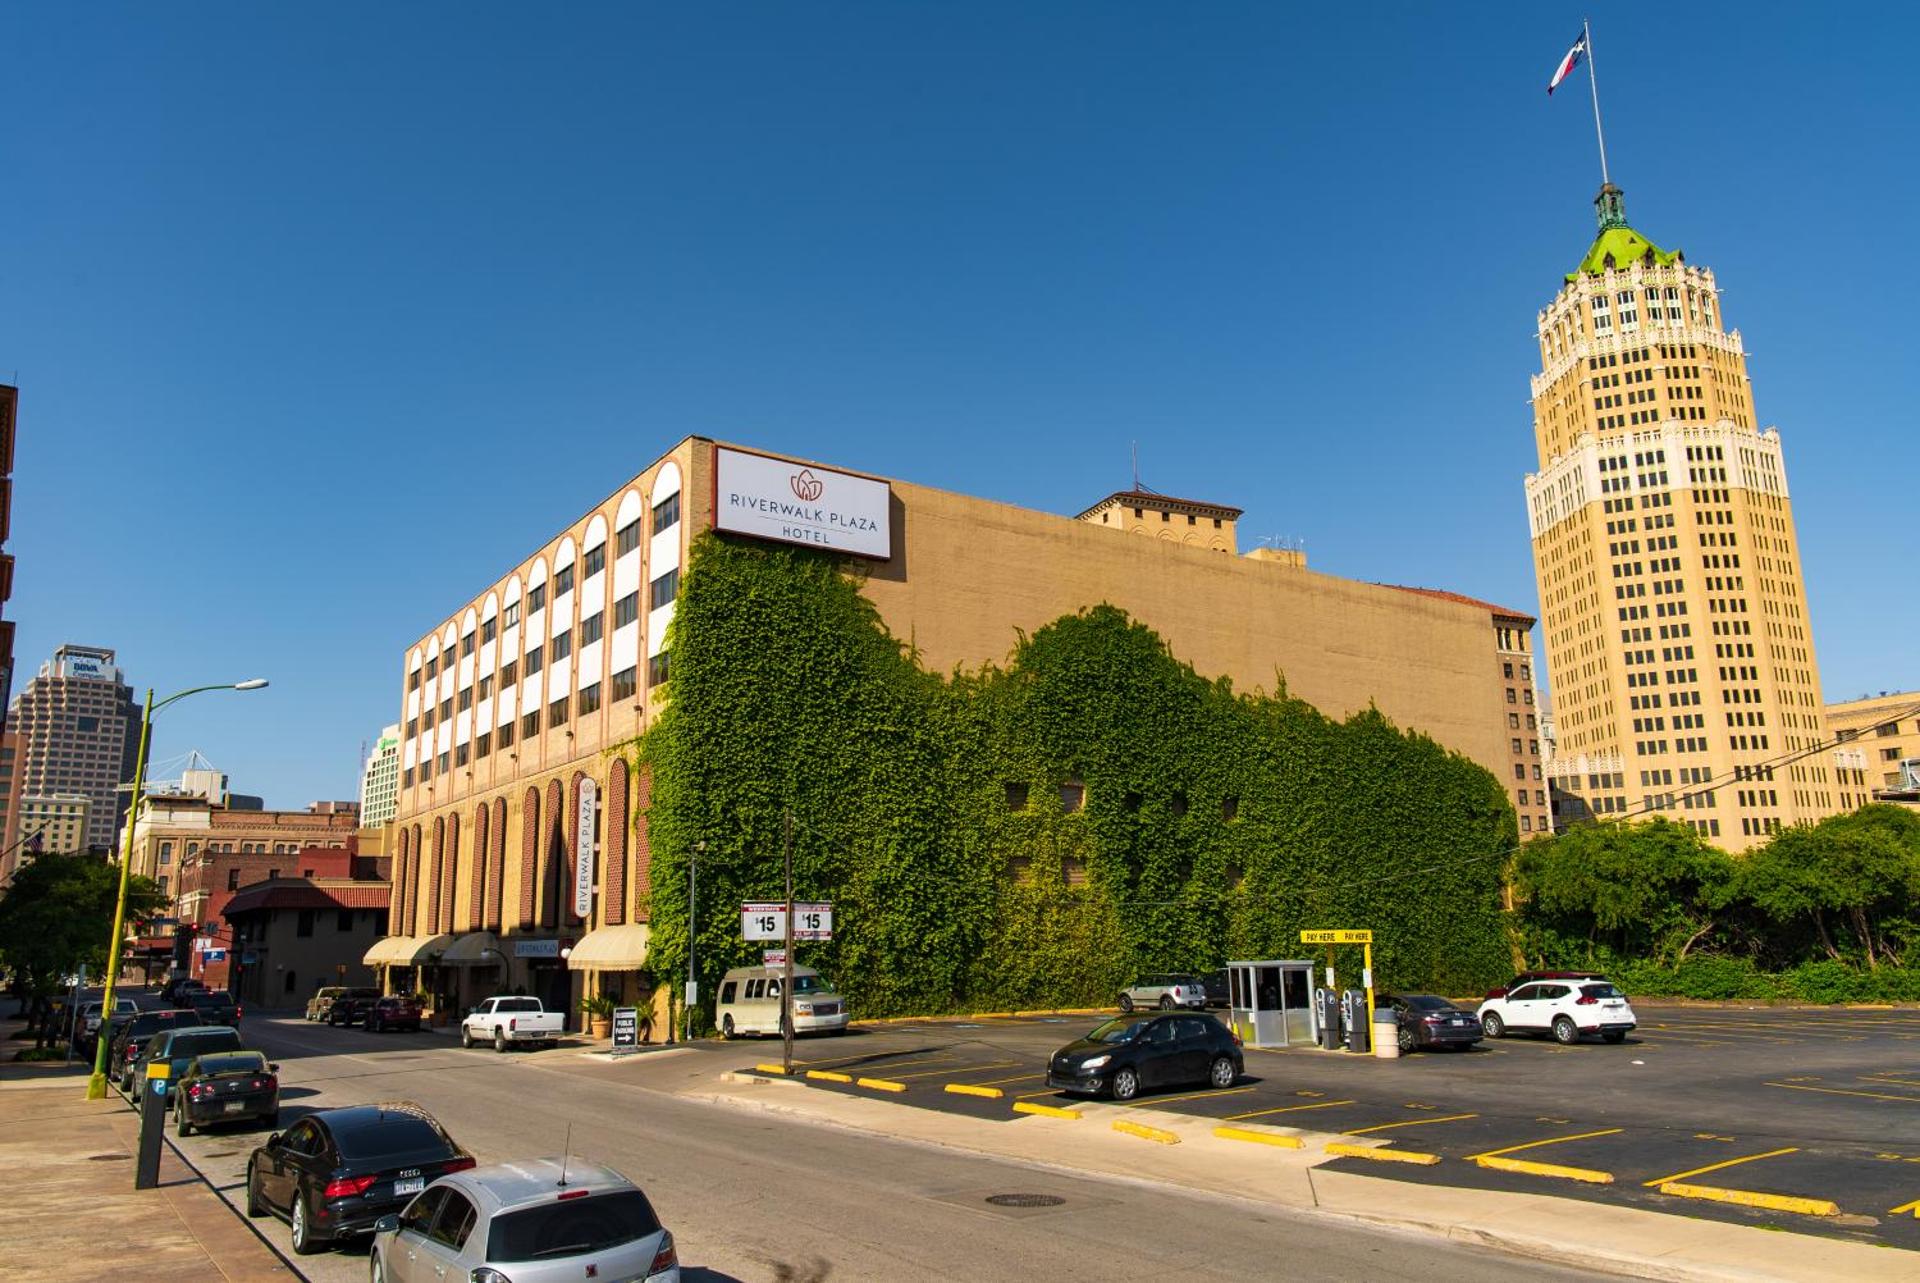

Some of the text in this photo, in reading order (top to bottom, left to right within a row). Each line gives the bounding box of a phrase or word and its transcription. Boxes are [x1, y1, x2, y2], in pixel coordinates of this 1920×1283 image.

[730, 493, 878, 532] RIVERWALK PLAZA
[782, 526, 831, 544] HOTEL
[579, 798, 592, 911] RIVERWALK PLAZA
[1306, 932, 1336, 941] PAY HERE
[1344, 932, 1369, 940] PAY HERE
[155, 1080, 165, 1093] P
